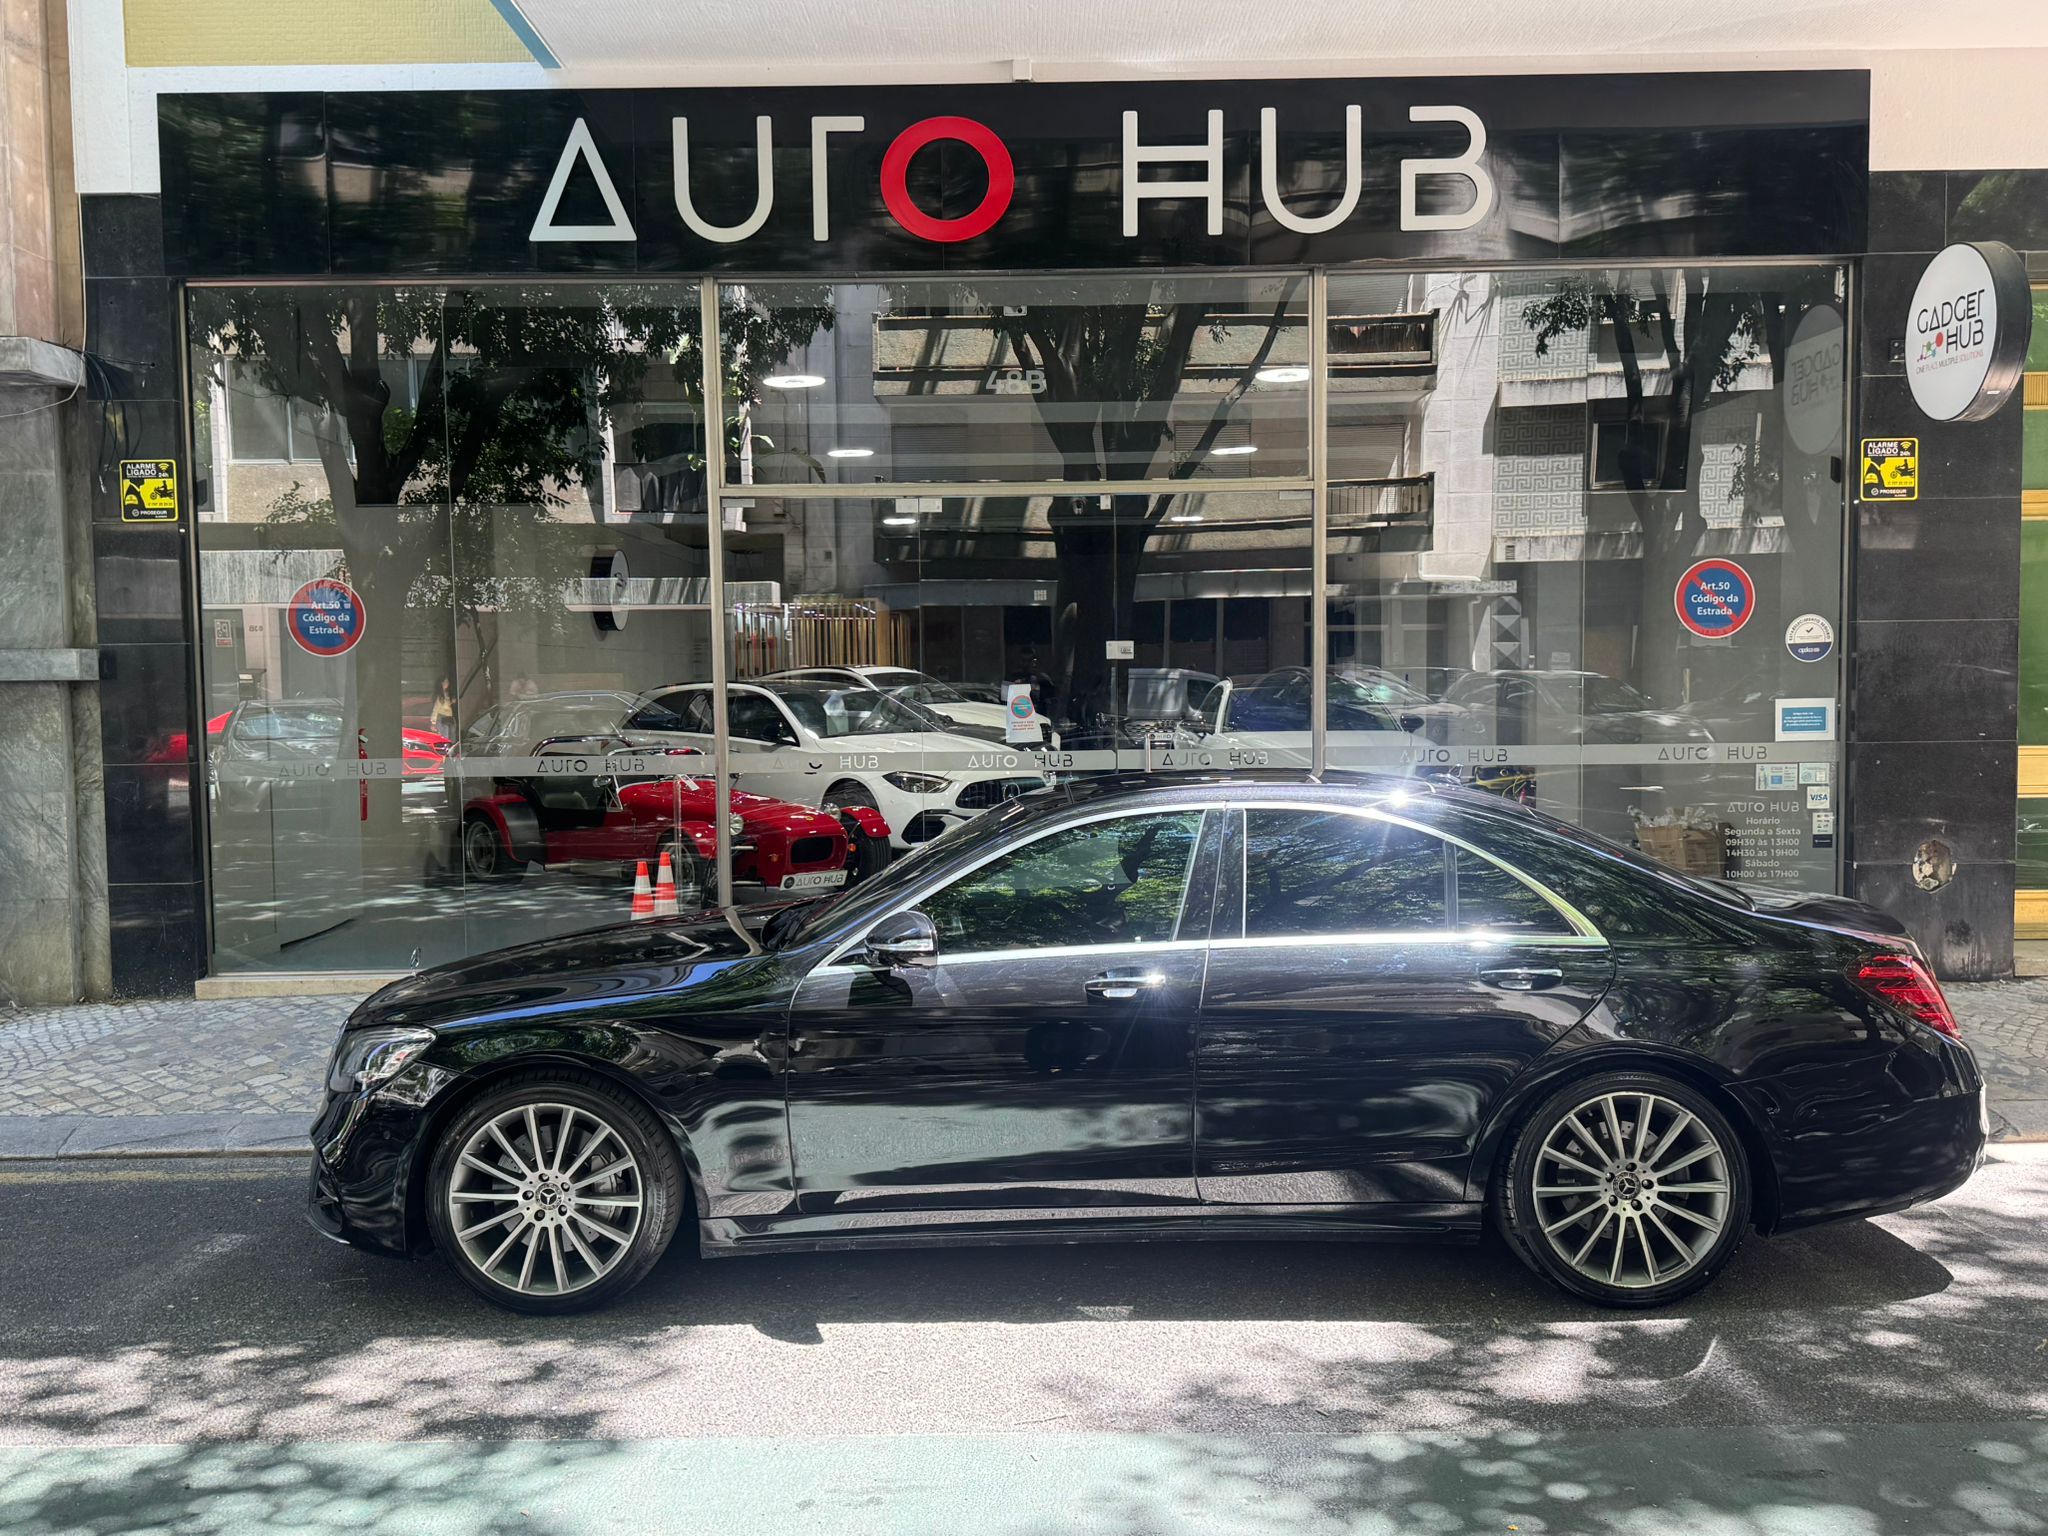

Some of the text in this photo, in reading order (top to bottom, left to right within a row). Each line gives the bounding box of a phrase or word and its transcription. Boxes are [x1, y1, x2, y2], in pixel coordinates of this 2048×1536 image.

[528, 105, 1493, 243] AUTO HUB
[1917, 289, 1985, 334] GADGET
[1946, 319, 1984, 353] HUB
[985, 370, 1047, 394] 48B
[1700, 582, 1731, 590] Art.50
[311, 601, 341, 610] Art.50
[1691, 594, 1739, 605] Código da
[1697, 606, 1733, 616] Estrada
[302, 613, 350, 624] Código da
[309, 625, 345, 635] Estrada
[1162, 751, 1269, 766] AUTO HUB
[1399, 748, 1508, 763] AUTO HUB
[1727, 746, 1768, 760] HUB
[537, 758, 645, 773] AUTO HUB
[839, 755, 879, 768] HUB
[967, 754, 1075, 768] AUTO HUB
[279, 761, 388, 778] AUTO HUB
[1727, 801, 1800, 813] AUTO HUB
[1745, 816, 1781, 825] Horário
[1724, 827, 1765, 837] Segunda
[1775, 827, 1801, 835] Sexta
[1725, 837, 1800, 846] 09H30 às 13H00
[1726, 848, 1755, 857] 14H30
[1770, 848, 1800, 857] 19H00
[1745, 858, 1780, 867] Sábado
[1725, 869, 1799, 878] 10H00 às 17H00
[795, 874, 844, 887] AUTO HUB
